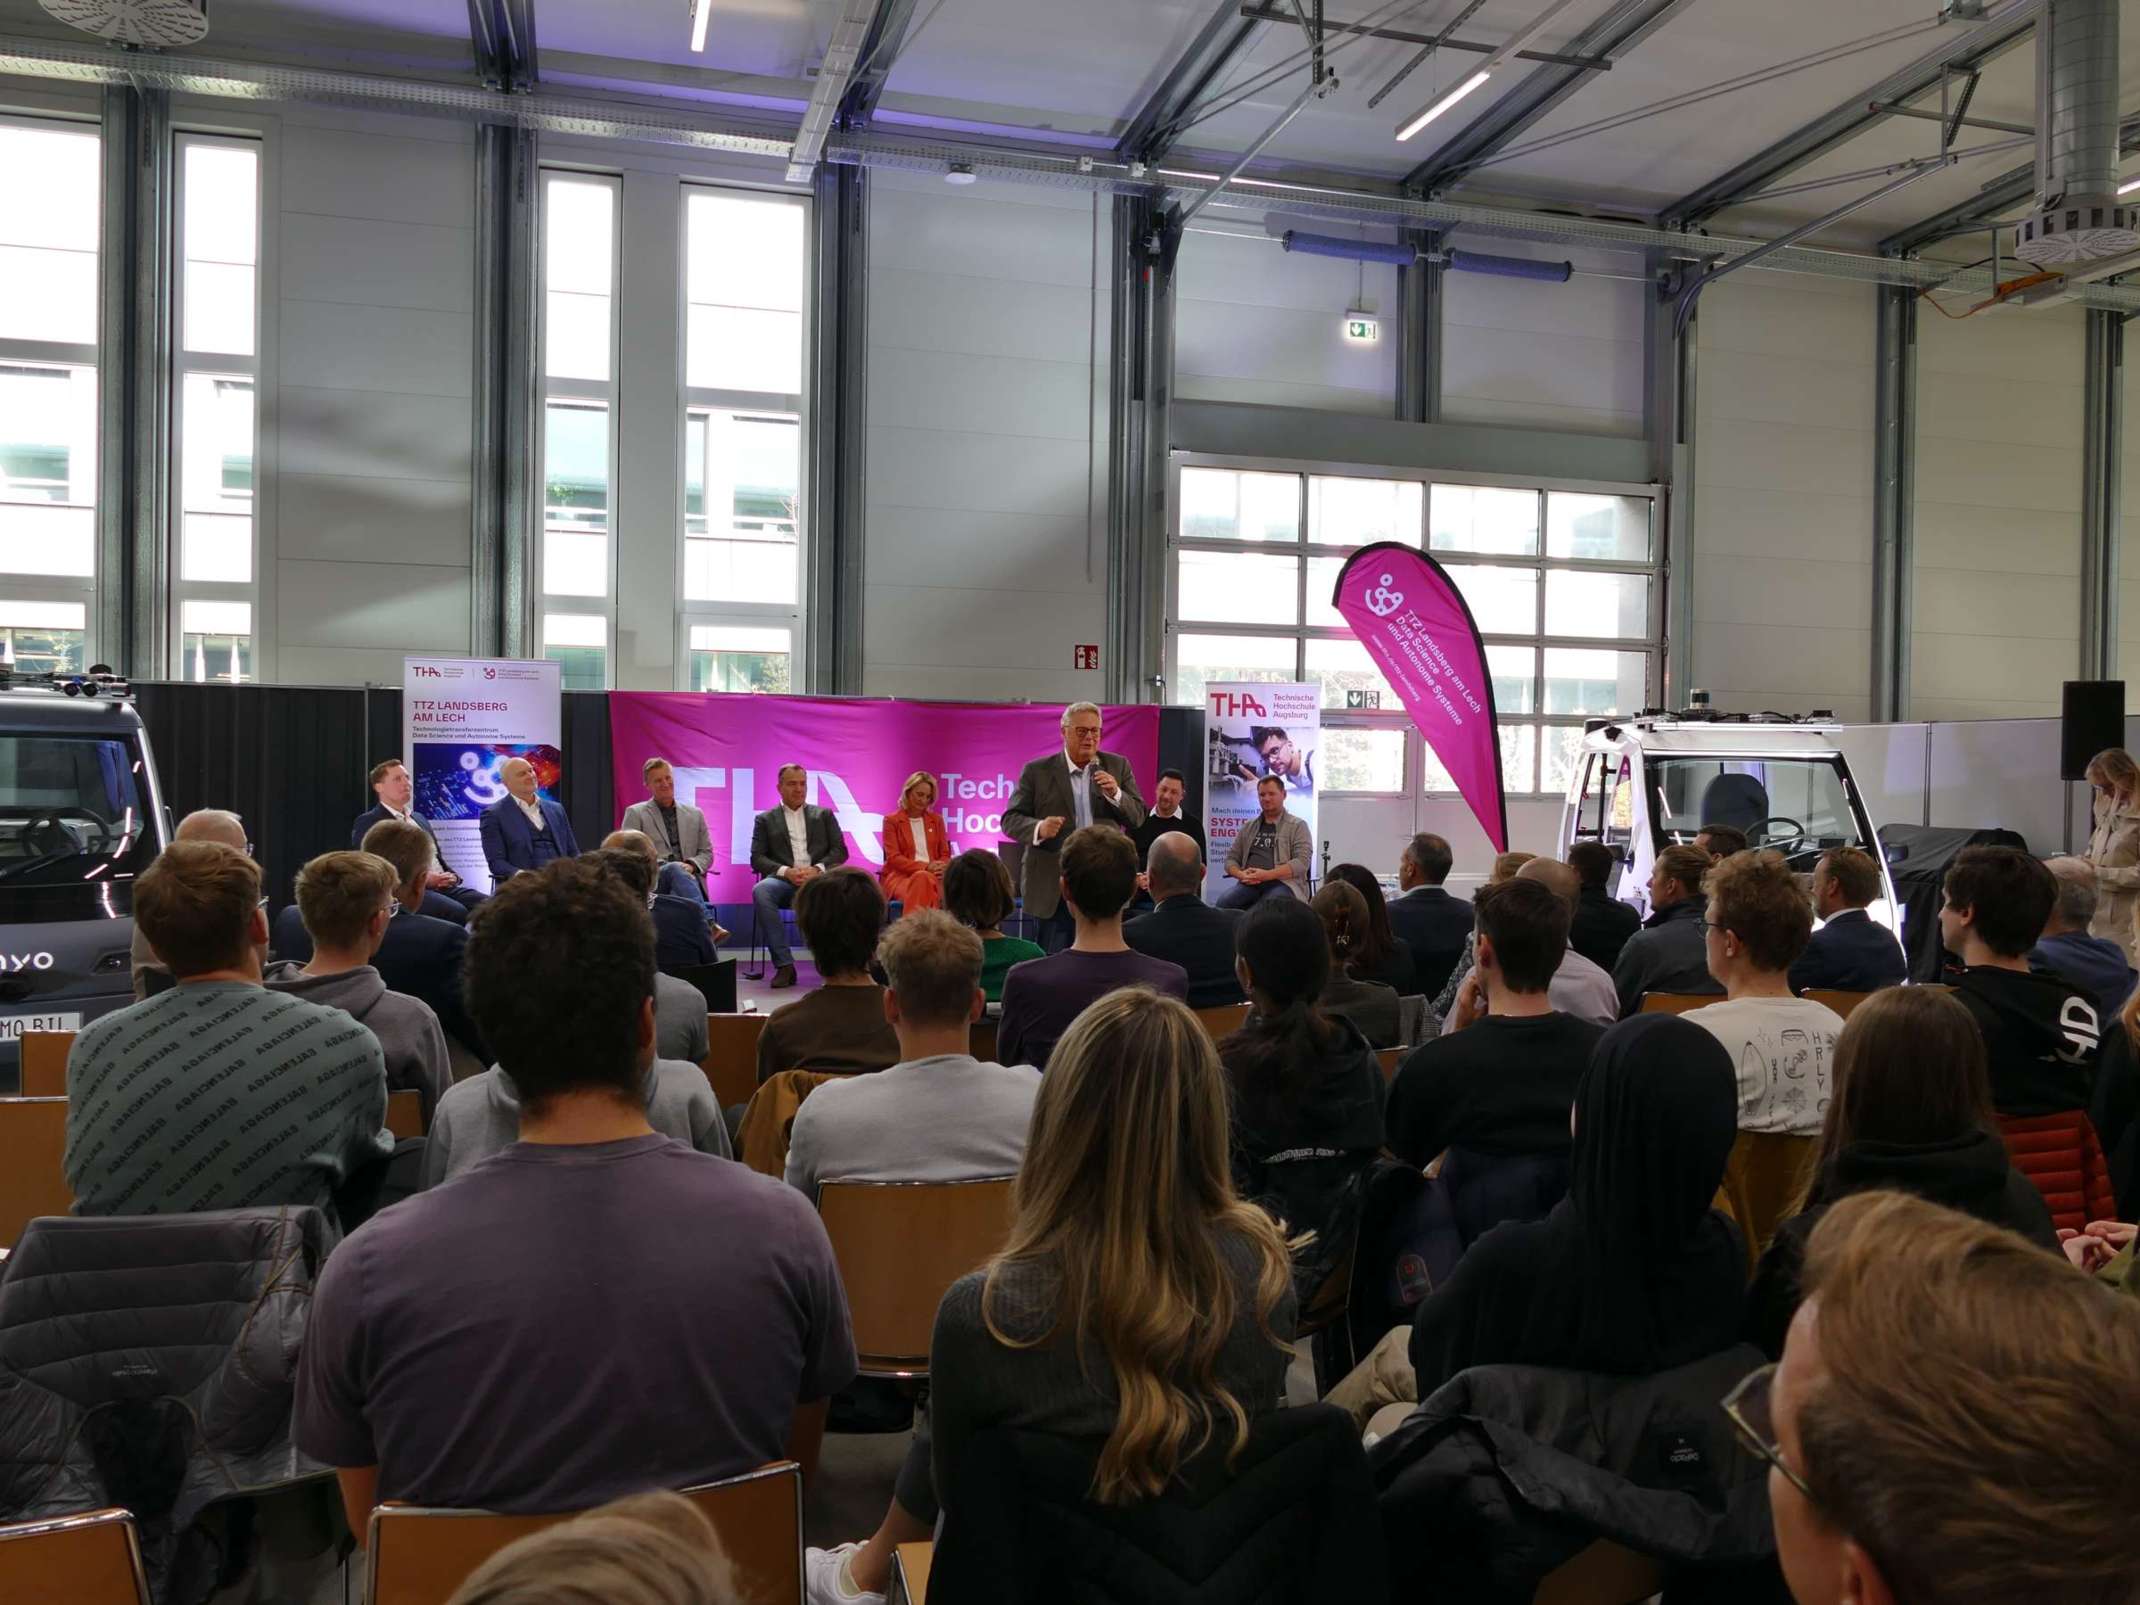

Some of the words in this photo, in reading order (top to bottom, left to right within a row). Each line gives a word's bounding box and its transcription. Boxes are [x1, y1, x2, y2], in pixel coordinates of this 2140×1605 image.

[1397, 616, 1413, 639] Data
[1413, 639, 1440, 674] Science
[1406, 609, 1423, 630] TTZ
[1419, 628, 1454, 676] Landsberg
[1452, 676, 1464, 691] am
[1462, 689, 1481, 714] Lech
[412, 666, 441, 677] THA
[1388, 623, 1402, 642] und
[1400, 641, 1435, 687] Autonome
[1433, 685, 1463, 726] Systeme
[1273, 693, 1314, 702] Technische
[413, 701, 434, 710] TTZ
[437, 702, 508, 711] LANDSBERG
[1210, 693, 1267, 717] THA
[1273, 702, 1316, 710] Hochschule
[413, 713, 433, 722] AM
[436, 713, 466, 722] LECH
[1273, 711, 1308, 719] Augsburg
[941, 773, 1015, 799] Tech
[942, 807, 1002, 833] Hoc
[1211, 828, 1239, 837] ENG
